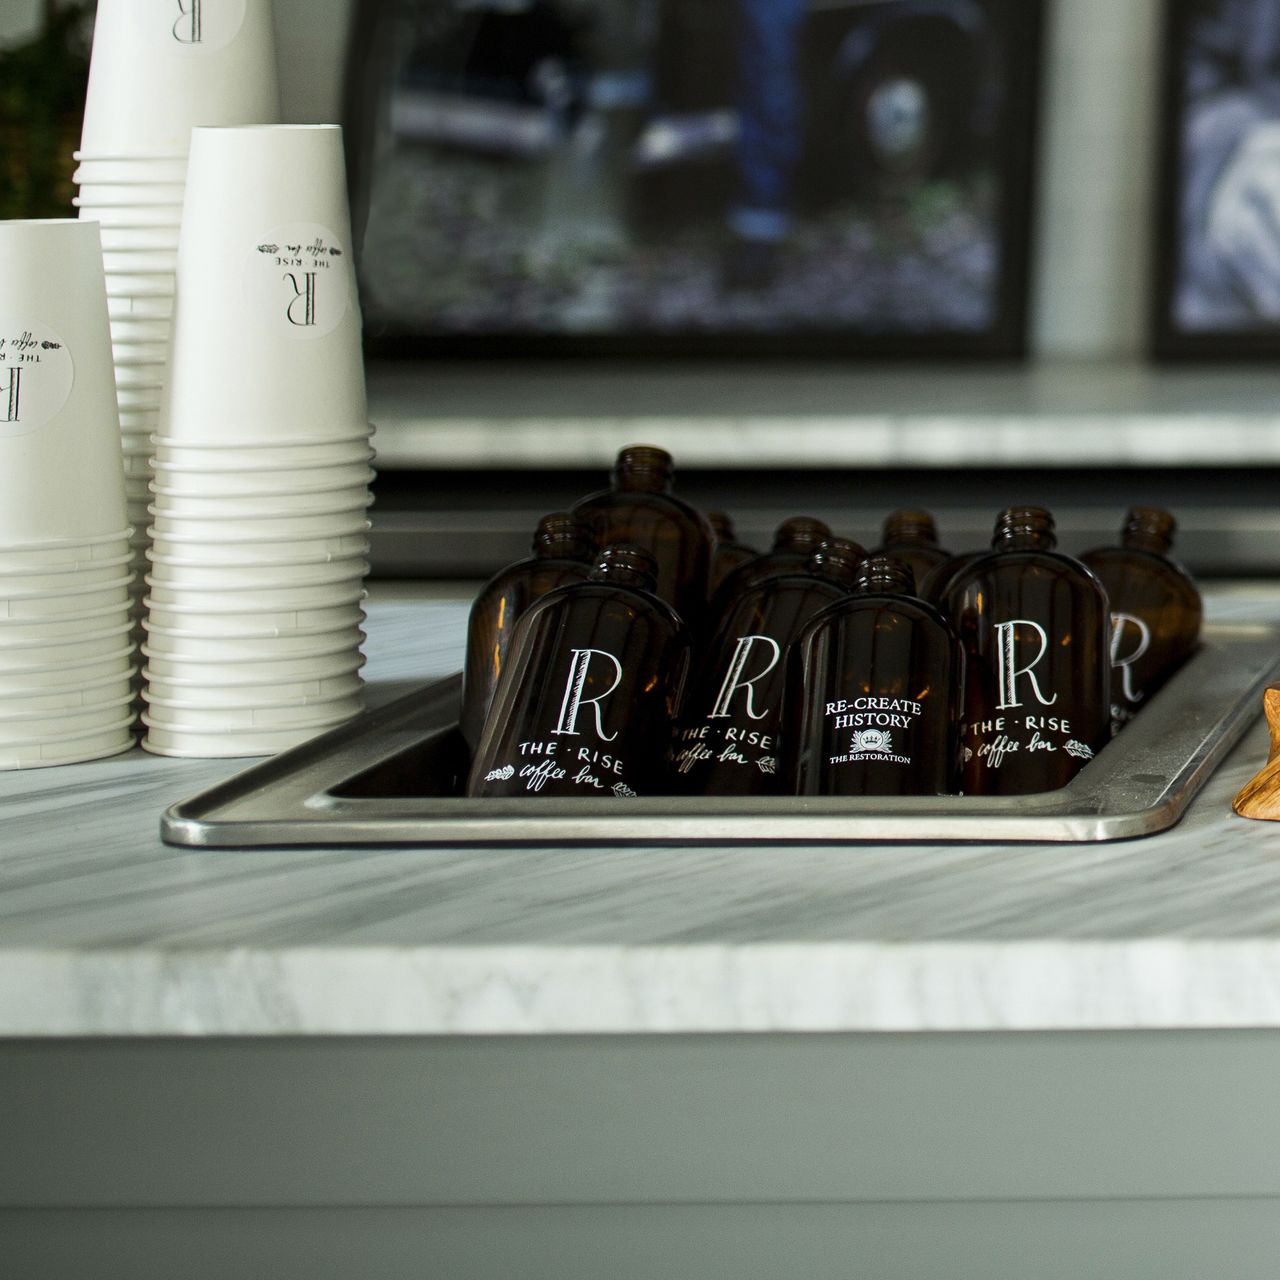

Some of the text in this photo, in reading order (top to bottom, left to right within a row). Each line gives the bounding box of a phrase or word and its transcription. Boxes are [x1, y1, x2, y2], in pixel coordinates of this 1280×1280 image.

[275, 257, 330, 268] THE RISE
[283, 272, 317, 326] R
[18, 354, 42, 362] THE
[994, 620, 1057, 710] R
[707, 635, 780, 720] R
[551, 649, 622, 741] R
[825, 698, 922, 716] RE-CREATE
[835, 713, 912, 729] HISTORY
[970, 716, 1071, 736] THE RISE
[682, 726, 772, 750] THE RISE
[977, 732, 1057, 768] coffee bar
[519, 742, 624, 775] THE RISE
[716, 743, 748, 764] bar
[830, 753, 911, 765] THE RESTORATION
[519, 759, 605, 792] coffee bar
